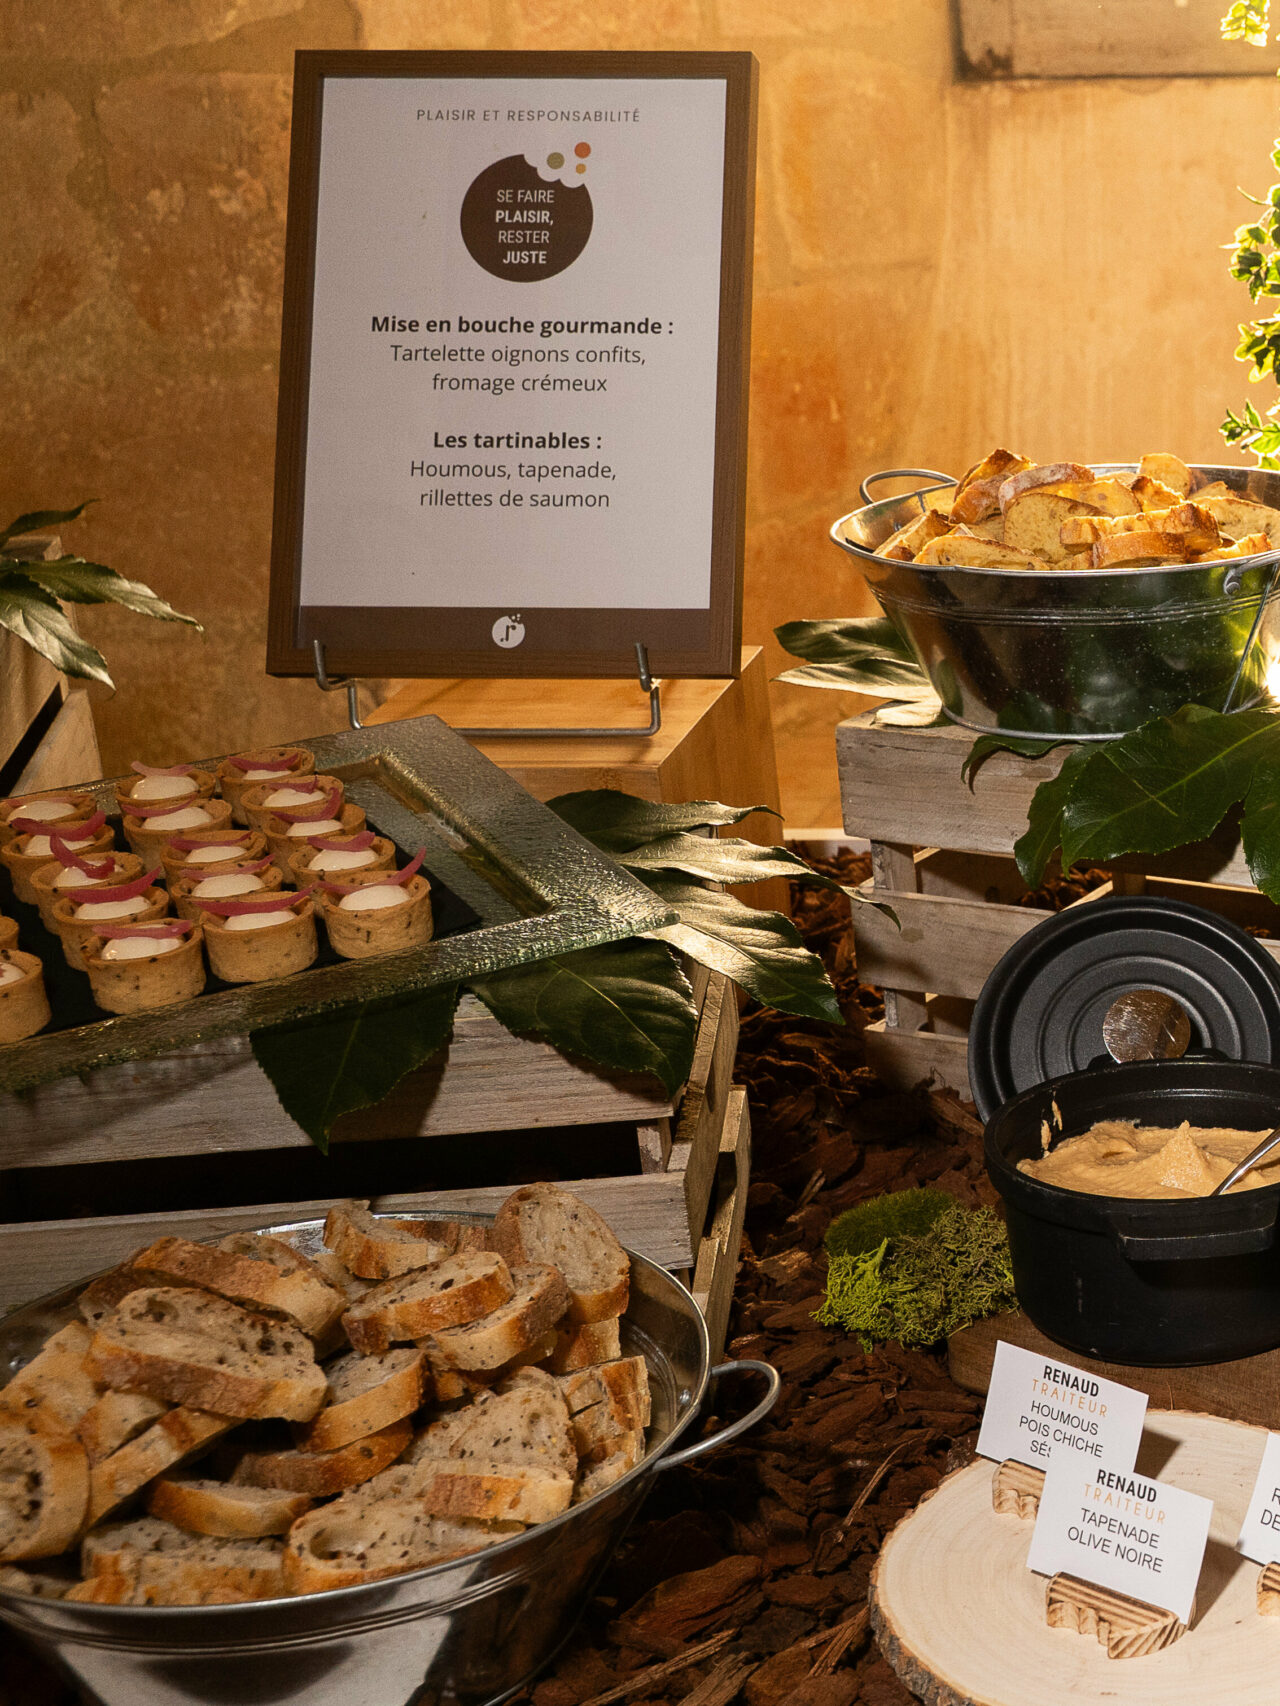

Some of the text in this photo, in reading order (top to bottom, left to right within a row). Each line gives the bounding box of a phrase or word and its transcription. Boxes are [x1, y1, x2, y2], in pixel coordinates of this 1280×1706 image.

[416, 108, 640, 122] PLAISIR ET RESPONSABILITÉ
[496, 189, 555, 203] SE FAIRE
[495, 210, 554, 225] PLAISIR,
[498, 230, 550, 244] RESTER
[502, 250, 547, 264] JUSTE
[371, 315, 420, 333] Mise
[426, 320, 452, 333] en
[458, 315, 535, 334] bouche
[540, 315, 662, 338] gourmande
[390, 344, 646, 367] Tartelette oignons confits,
[432, 373, 608, 395] fromage crémeux
[433, 432, 467, 449] Les
[473, 432, 591, 450] tartinables
[410, 461, 617, 483] Houmous, tapenade,
[420, 490, 610, 508] rillettes de saumon
[1042, 1365, 1100, 1398] RENAUD
[1032, 1378, 1108, 1418] TRAITEUR
[1030, 1400, 1099, 1436] HOUMOUS
[1019, 1415, 1104, 1458] POIS CHICHE
[1096, 1468, 1158, 1503] RENAUD
[1083, 1482, 1167, 1525] TRAITEUR
[1080, 1508, 1161, 1549] TAPENADE
[1067, 1526, 1164, 1573] OLIVE NOIRE
